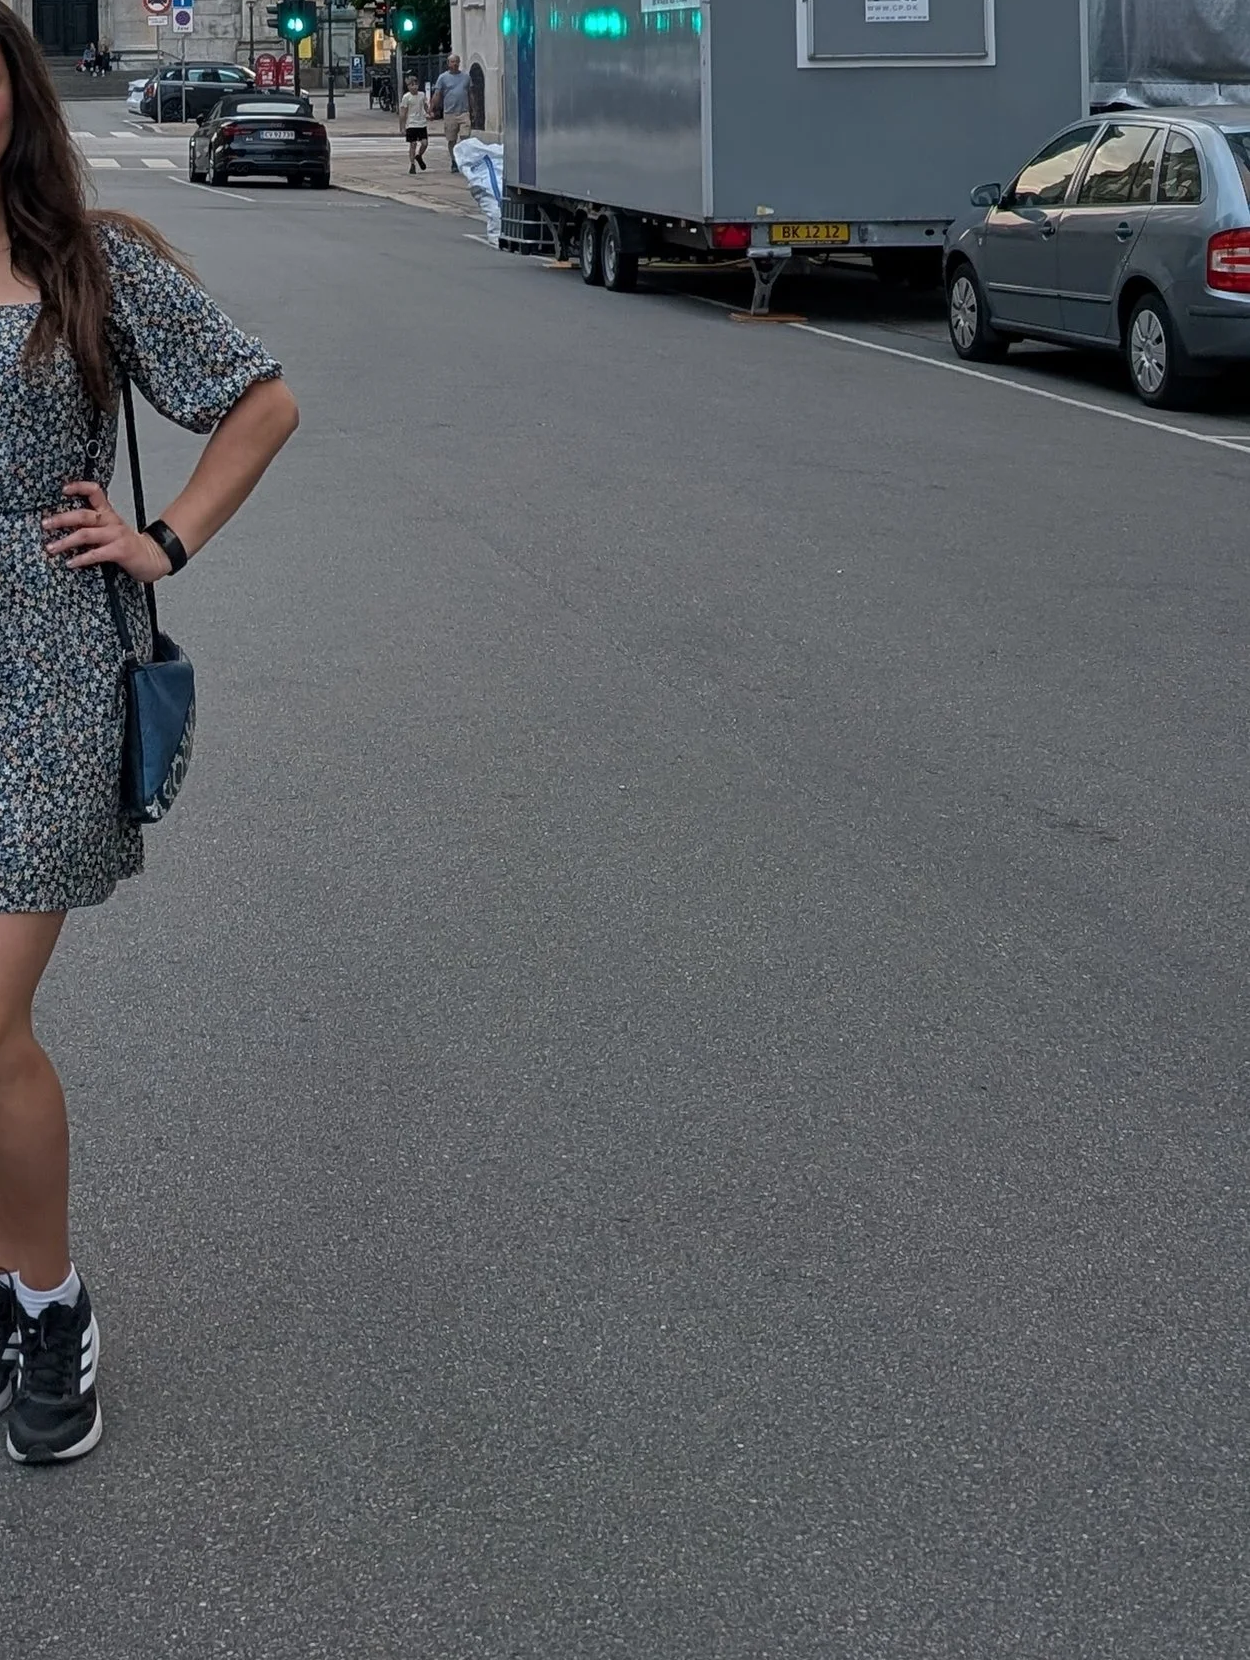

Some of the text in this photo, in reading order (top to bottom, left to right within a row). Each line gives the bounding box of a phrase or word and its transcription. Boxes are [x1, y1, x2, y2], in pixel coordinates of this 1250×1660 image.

[782, 225, 840, 239] BK 12 12
